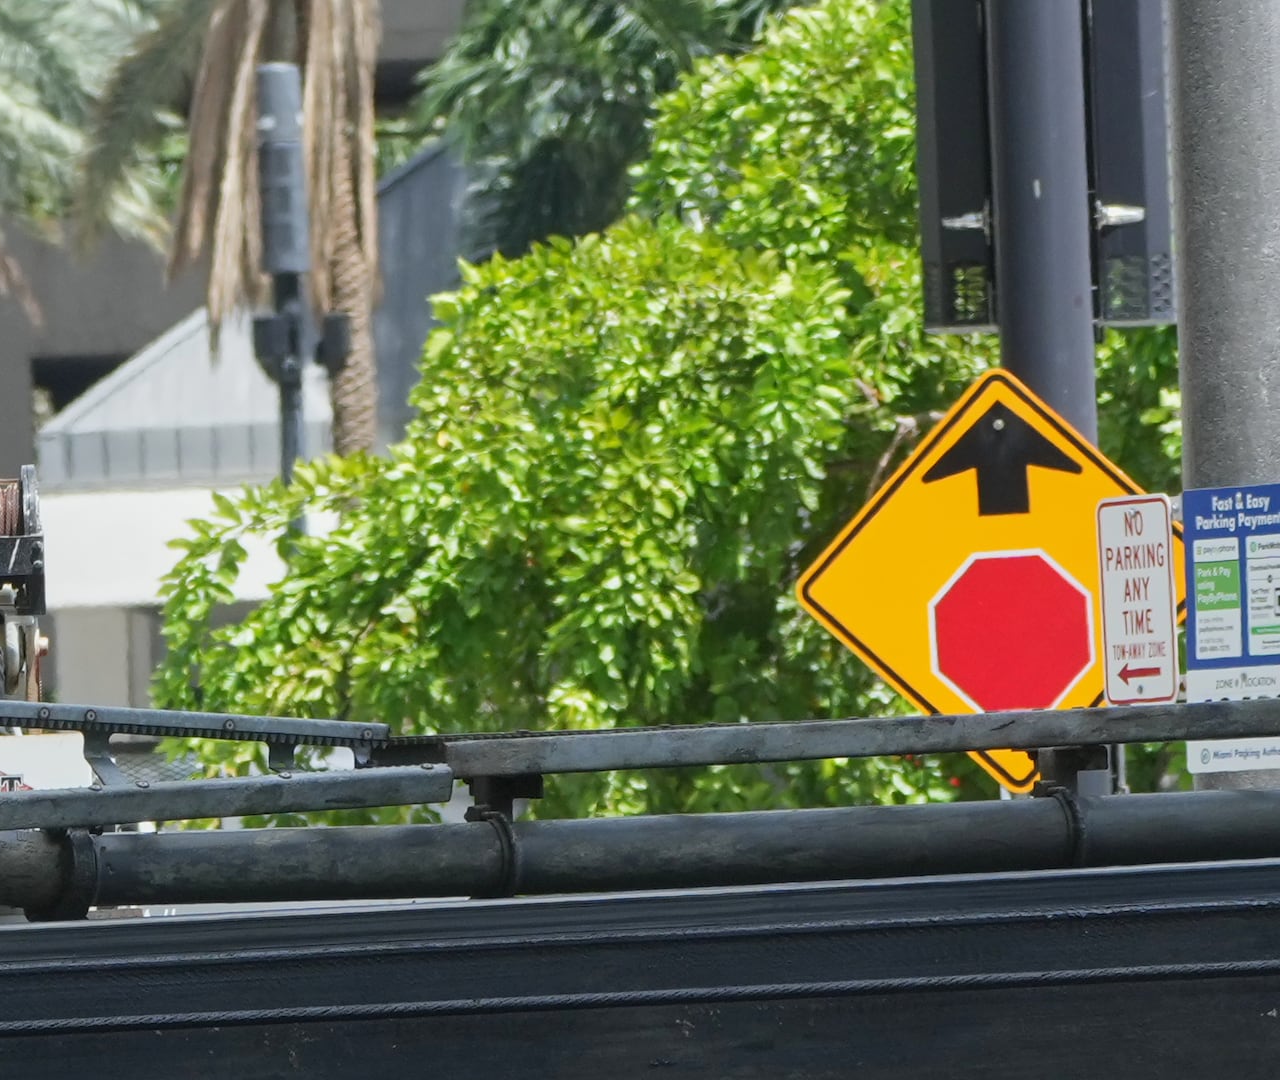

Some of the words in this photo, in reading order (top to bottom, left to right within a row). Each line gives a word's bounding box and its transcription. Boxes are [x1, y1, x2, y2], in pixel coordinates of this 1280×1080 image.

[1212, 496, 1233, 511] Fast
[1246, 494, 1270, 512] Easy
[1124, 511, 1144, 537] NO
[1195, 514, 1235, 532] Parking
[1105, 543, 1165, 572] PARKING
[1197, 567, 1212, 577] Park
[1219, 566, 1231, 578] Pay
[1124, 576, 1150, 603] ANY
[1122, 609, 1154, 636] TIME
[1113, 643, 1146, 661] TOW-AWAY
[1148, 641, 1166, 658] ZONE
[1215, 679, 1233, 689] ZONE
